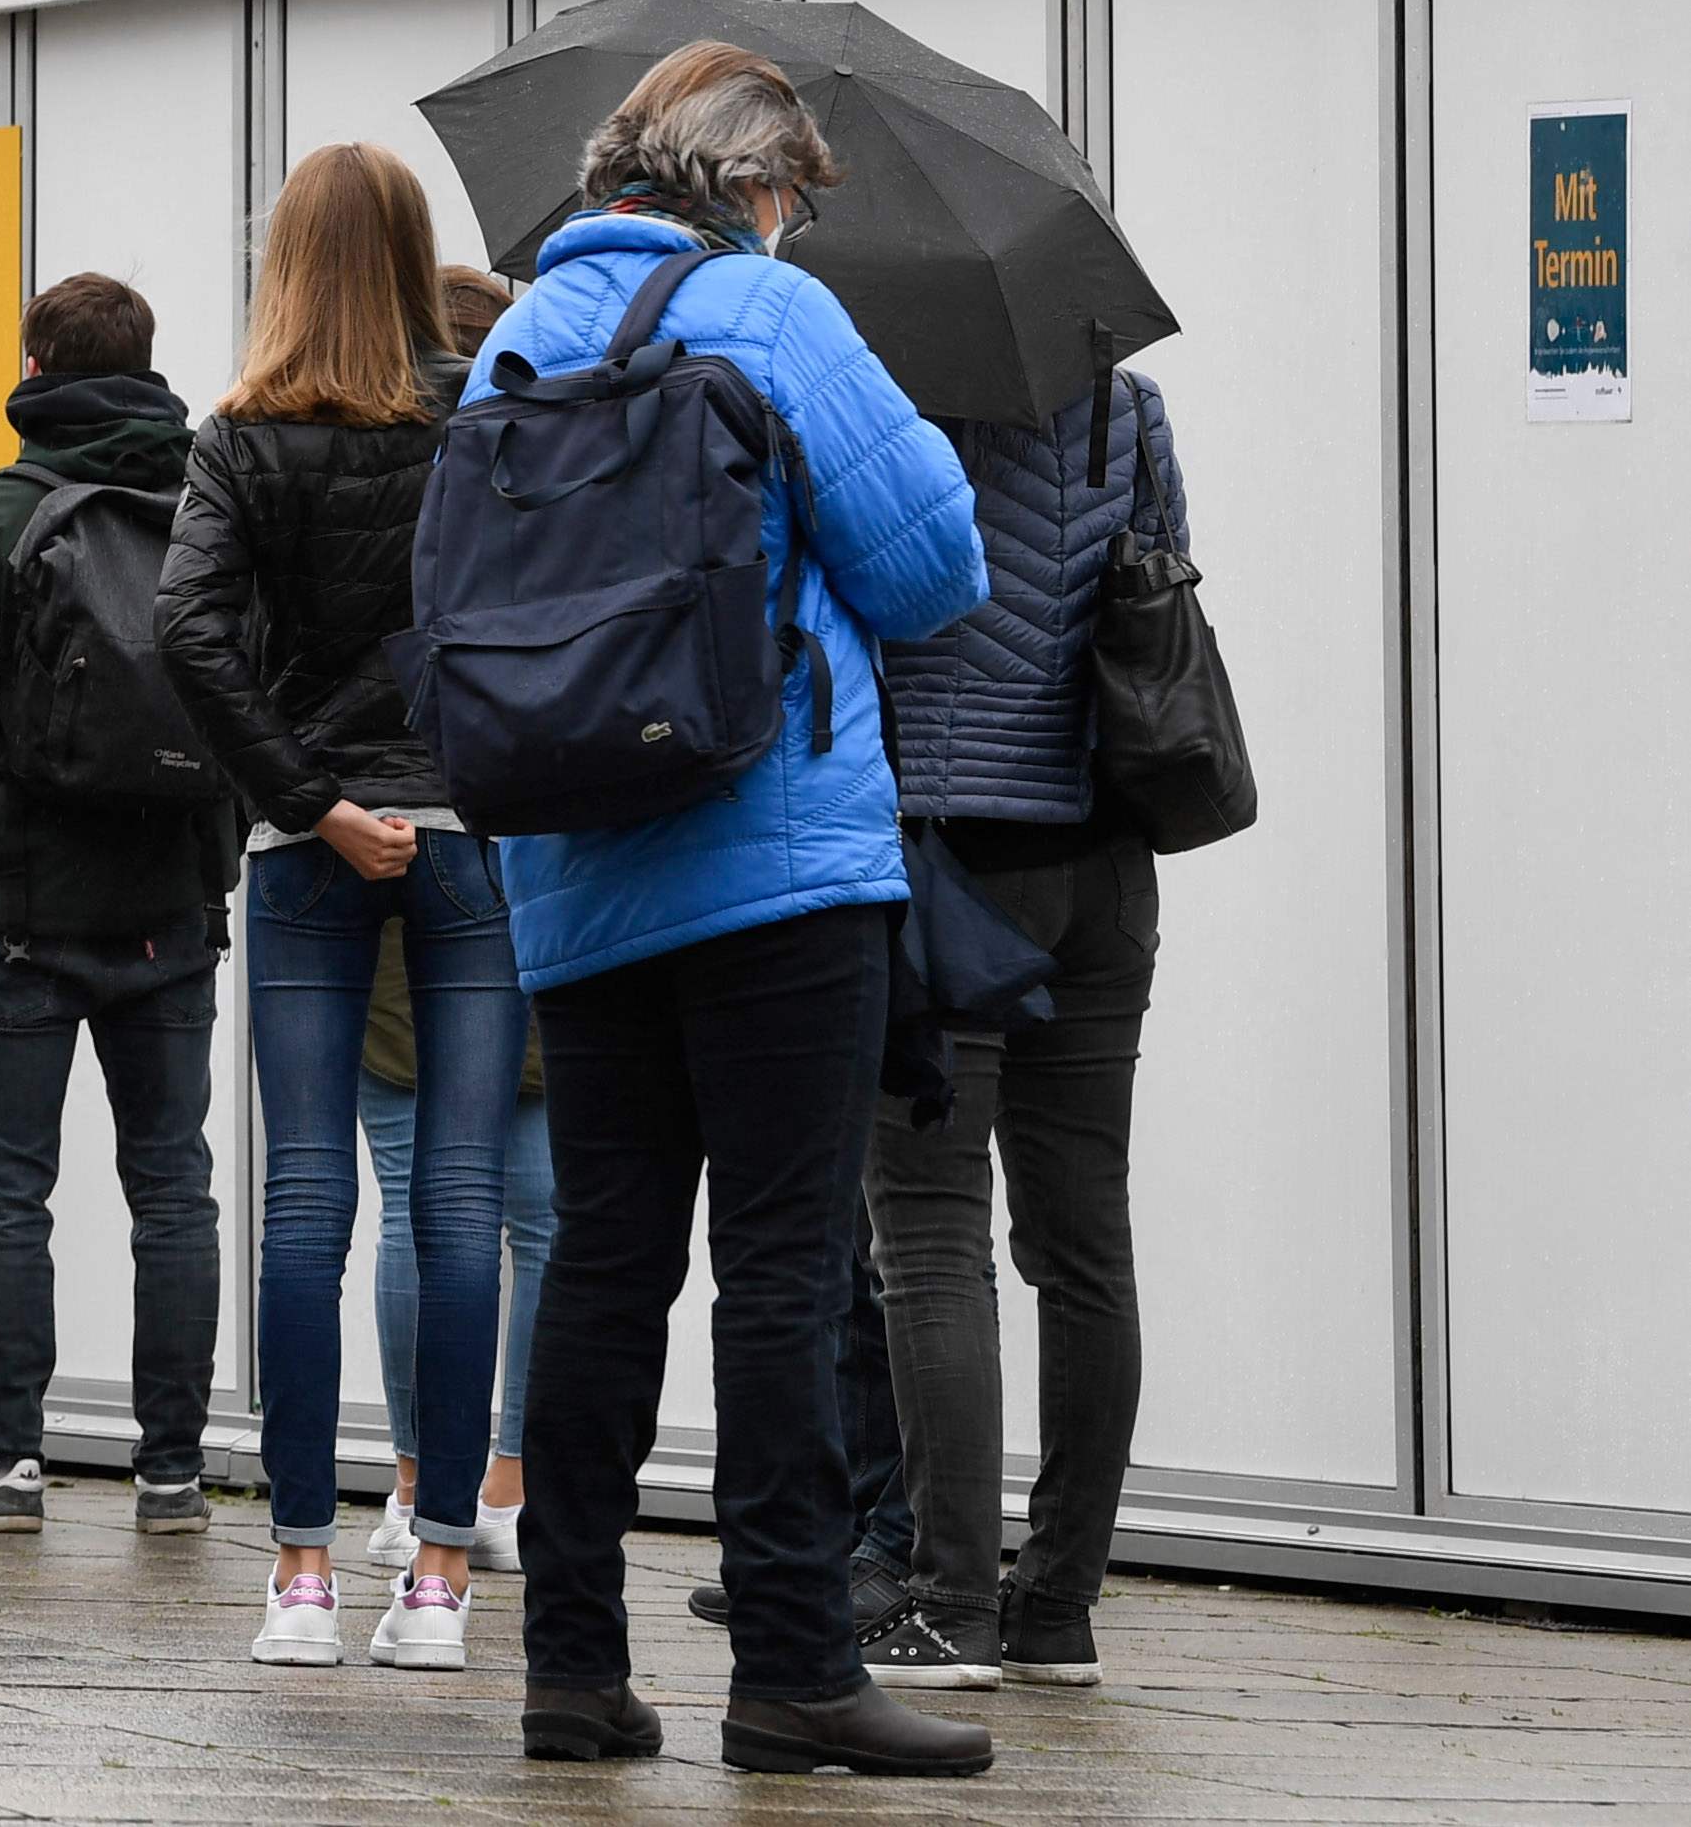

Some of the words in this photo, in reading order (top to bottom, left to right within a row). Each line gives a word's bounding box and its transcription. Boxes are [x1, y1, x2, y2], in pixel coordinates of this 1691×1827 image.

[1554, 169, 1598, 222] Mit
[1533, 236, 1618, 289] Termin
[290, 1586, 326, 1598] adidas
[415, 1588, 450, 1600] adidas
